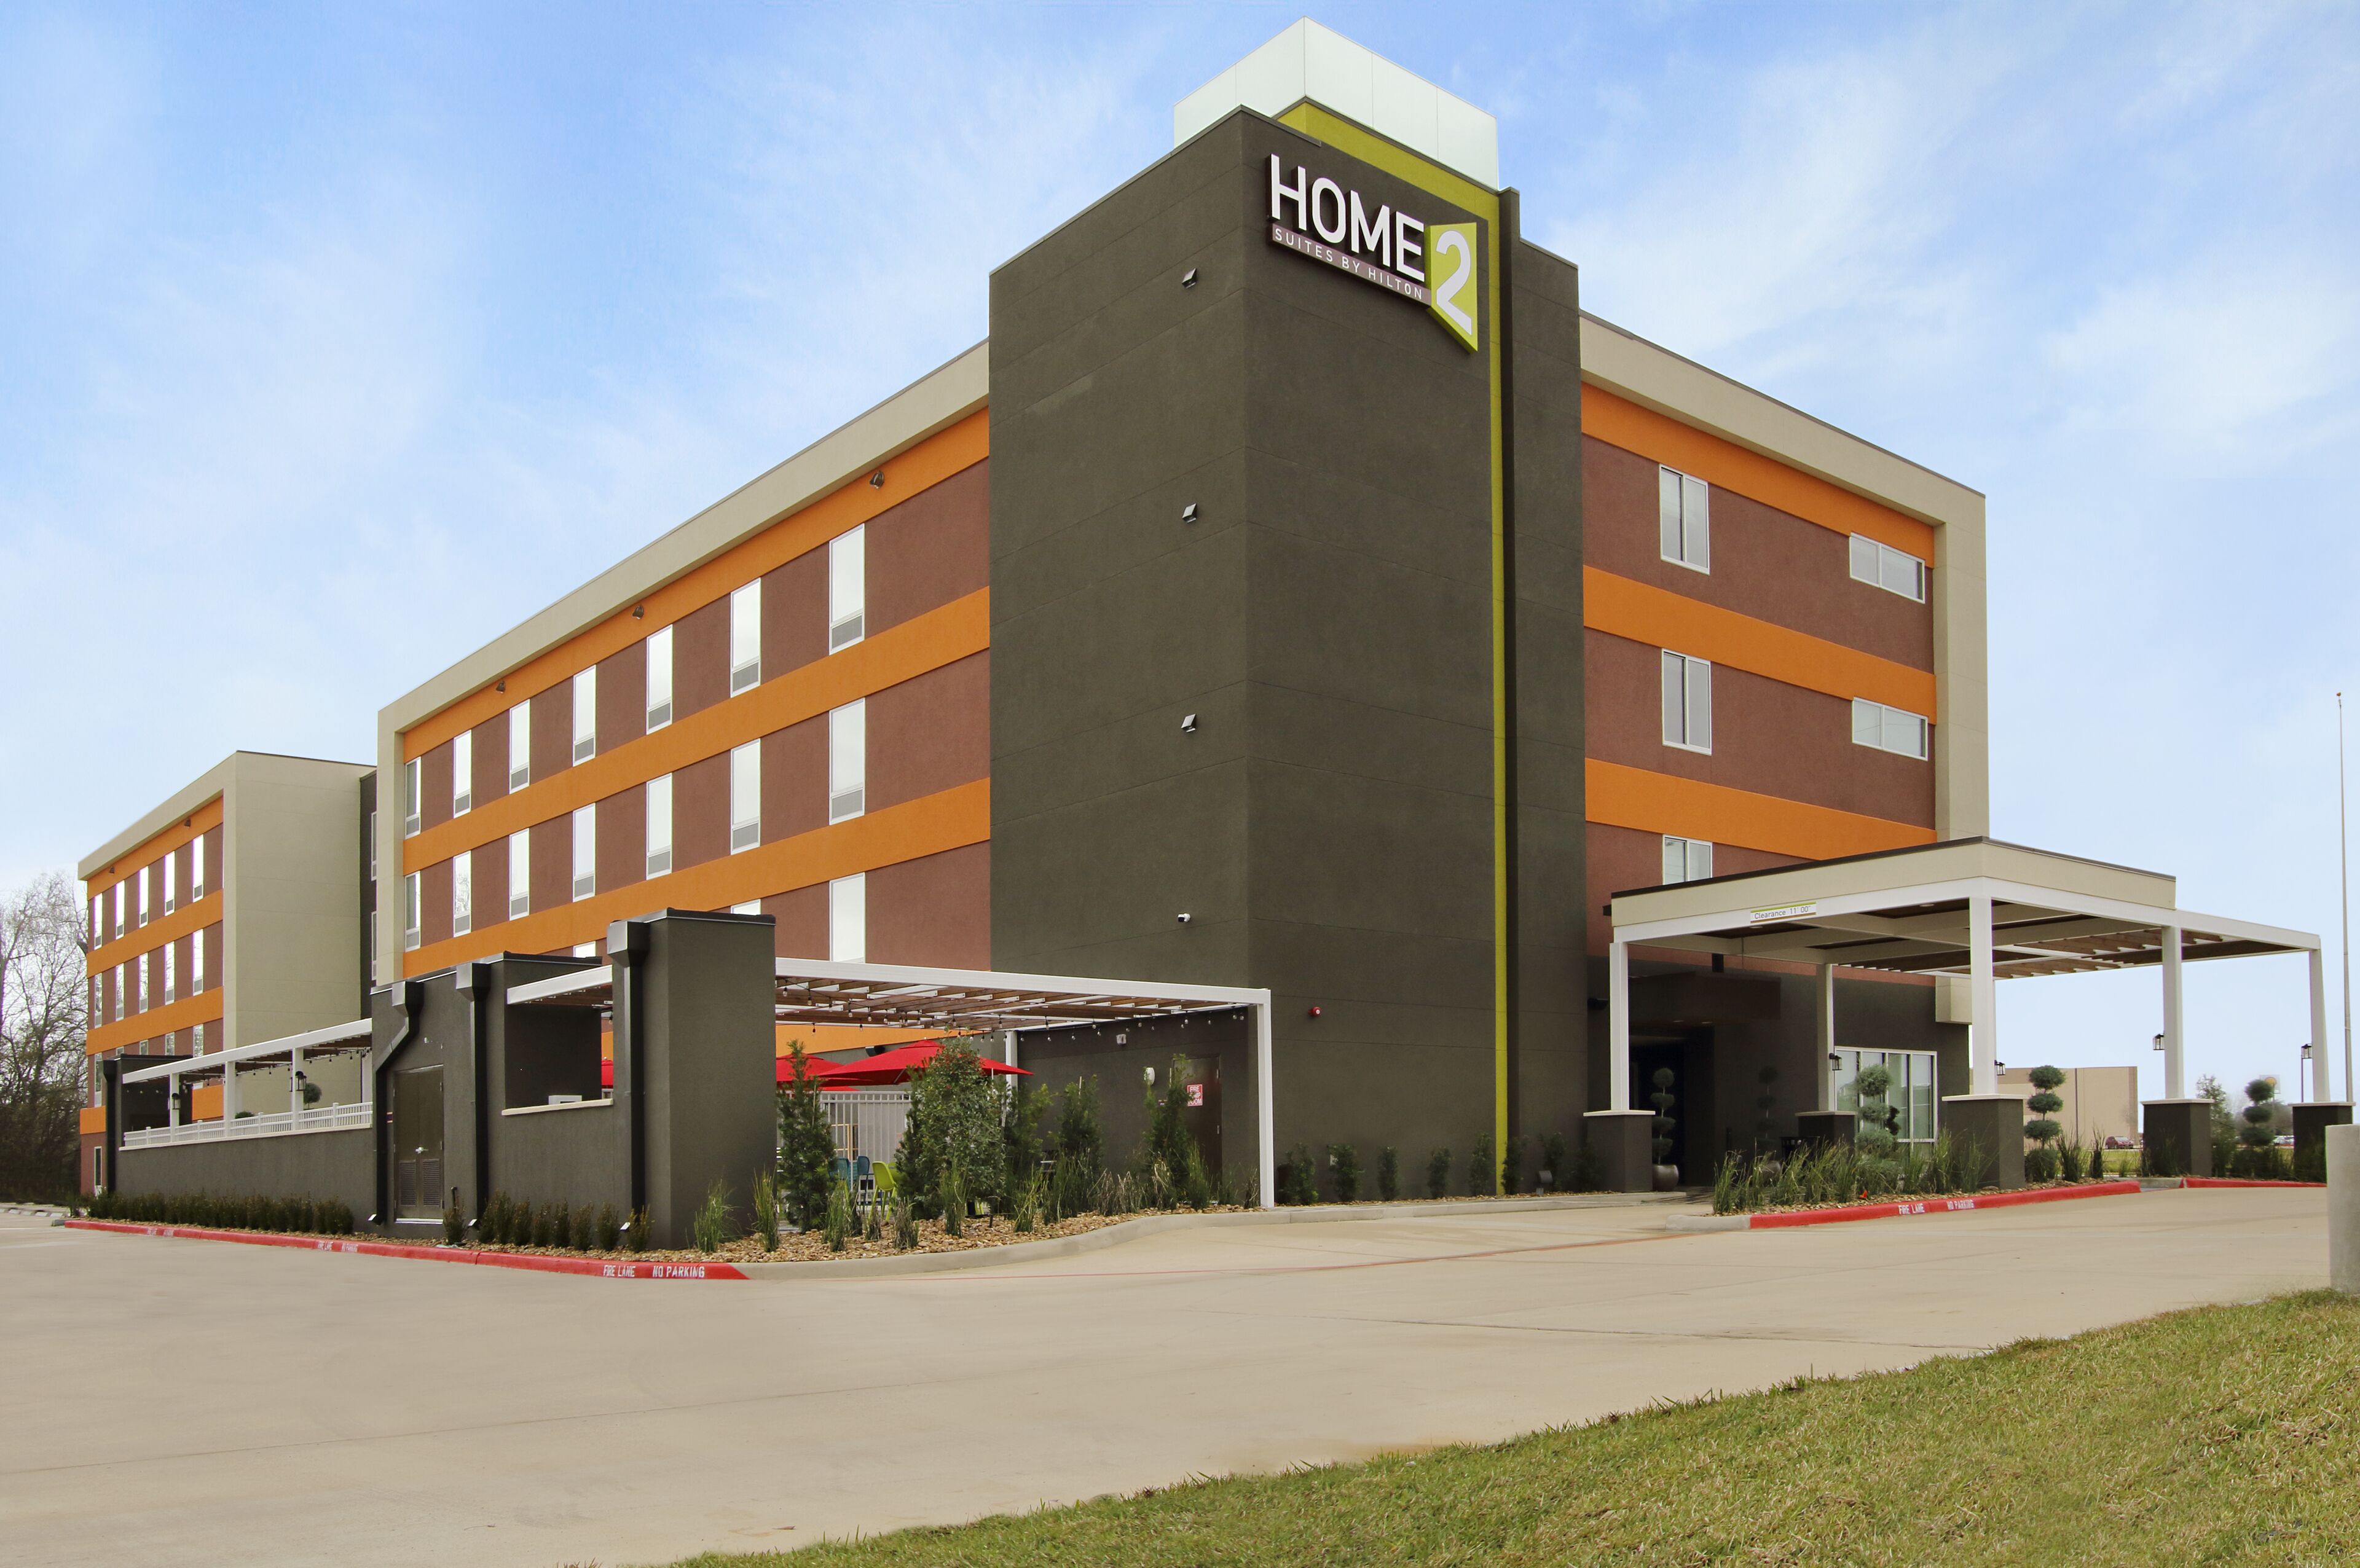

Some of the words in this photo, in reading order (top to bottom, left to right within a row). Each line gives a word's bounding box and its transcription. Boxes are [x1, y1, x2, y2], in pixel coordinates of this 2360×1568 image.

[1270, 154, 1425, 283] HOME
[1435, 229, 1472, 336] 2
[1275, 228, 1333, 262] SUITES
[1342, 257, 1360, 273] BY
[1368, 268, 1422, 300] HILTON
[1754, 911, 1786, 919] Clearance
[1898, 1204, 1910, 1215] FIRE
[1946, 1201, 1954, 1210] NO
[603, 1264, 616, 1277] FIRE
[617, 1265, 637, 1277] LANE
[652, 1265, 663, 1277] NO
[666, 1266, 705, 1278] PARKING
